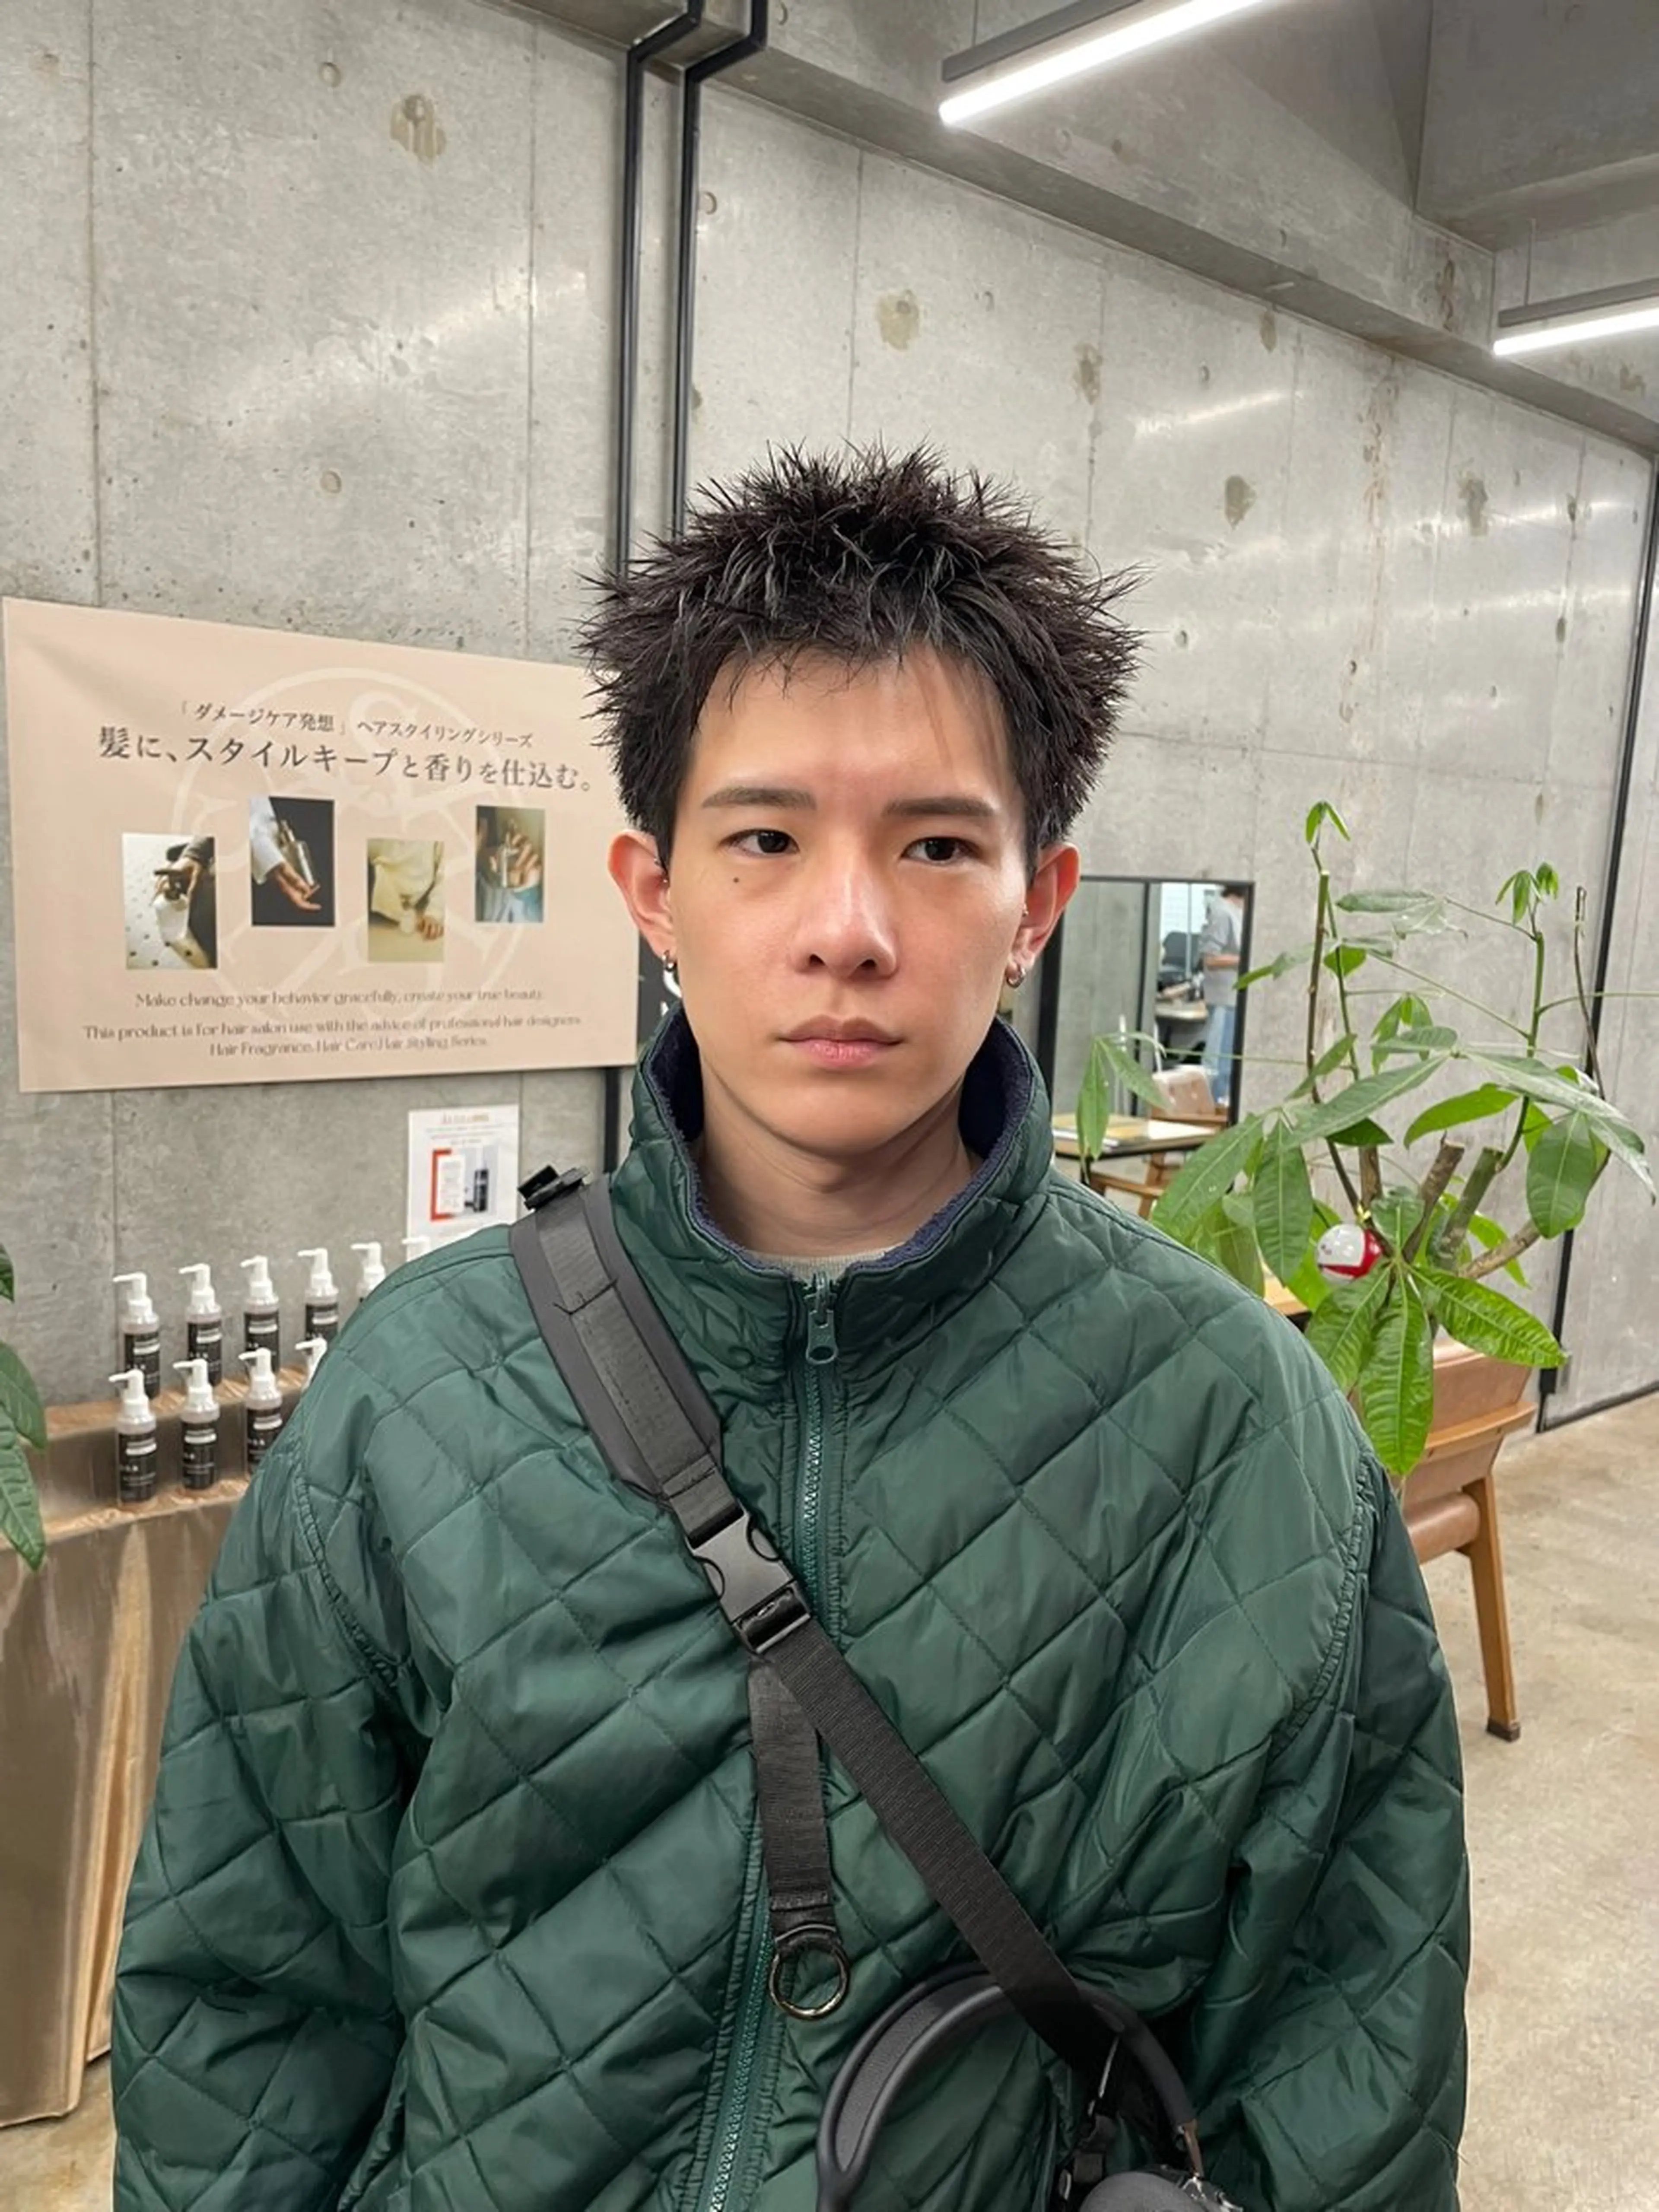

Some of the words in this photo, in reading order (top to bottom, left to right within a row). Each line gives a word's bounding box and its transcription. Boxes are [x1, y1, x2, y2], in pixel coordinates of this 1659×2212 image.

[357, 720, 533, 748] ヘアスタイリングシリーズ
[100, 725, 590, 792] 髪に、スタイルキープと香りを仕込む。
[135, 993, 176, 1007] Make
[179, 991, 234, 1007] change
[237, 995, 270, 1008] your
[83, 1024, 115, 1039] This
[118, 1023, 177, 1042] product
[182, 1025, 193, 1036] is
[196, 1023, 219, 1036] for
[221, 1022, 249, 1036] hair
[251, 1020, 287, 1034] salon
[289, 1023, 313, 1034] use
[316, 1019, 343, 1033] with
[346, 1018, 368, 1033] the
[370, 1018, 411, 1030] advice
[413, 1017, 426, 1030] of
[429, 1015, 501, 1031] professional
[503, 1015, 523, 1027] hair
[210, 1043, 238, 1057] Hair
[316, 1039, 340, 1053] Hair
[379, 1036, 404, 1050] Hair
[407, 1036, 449, 1051] Styling
